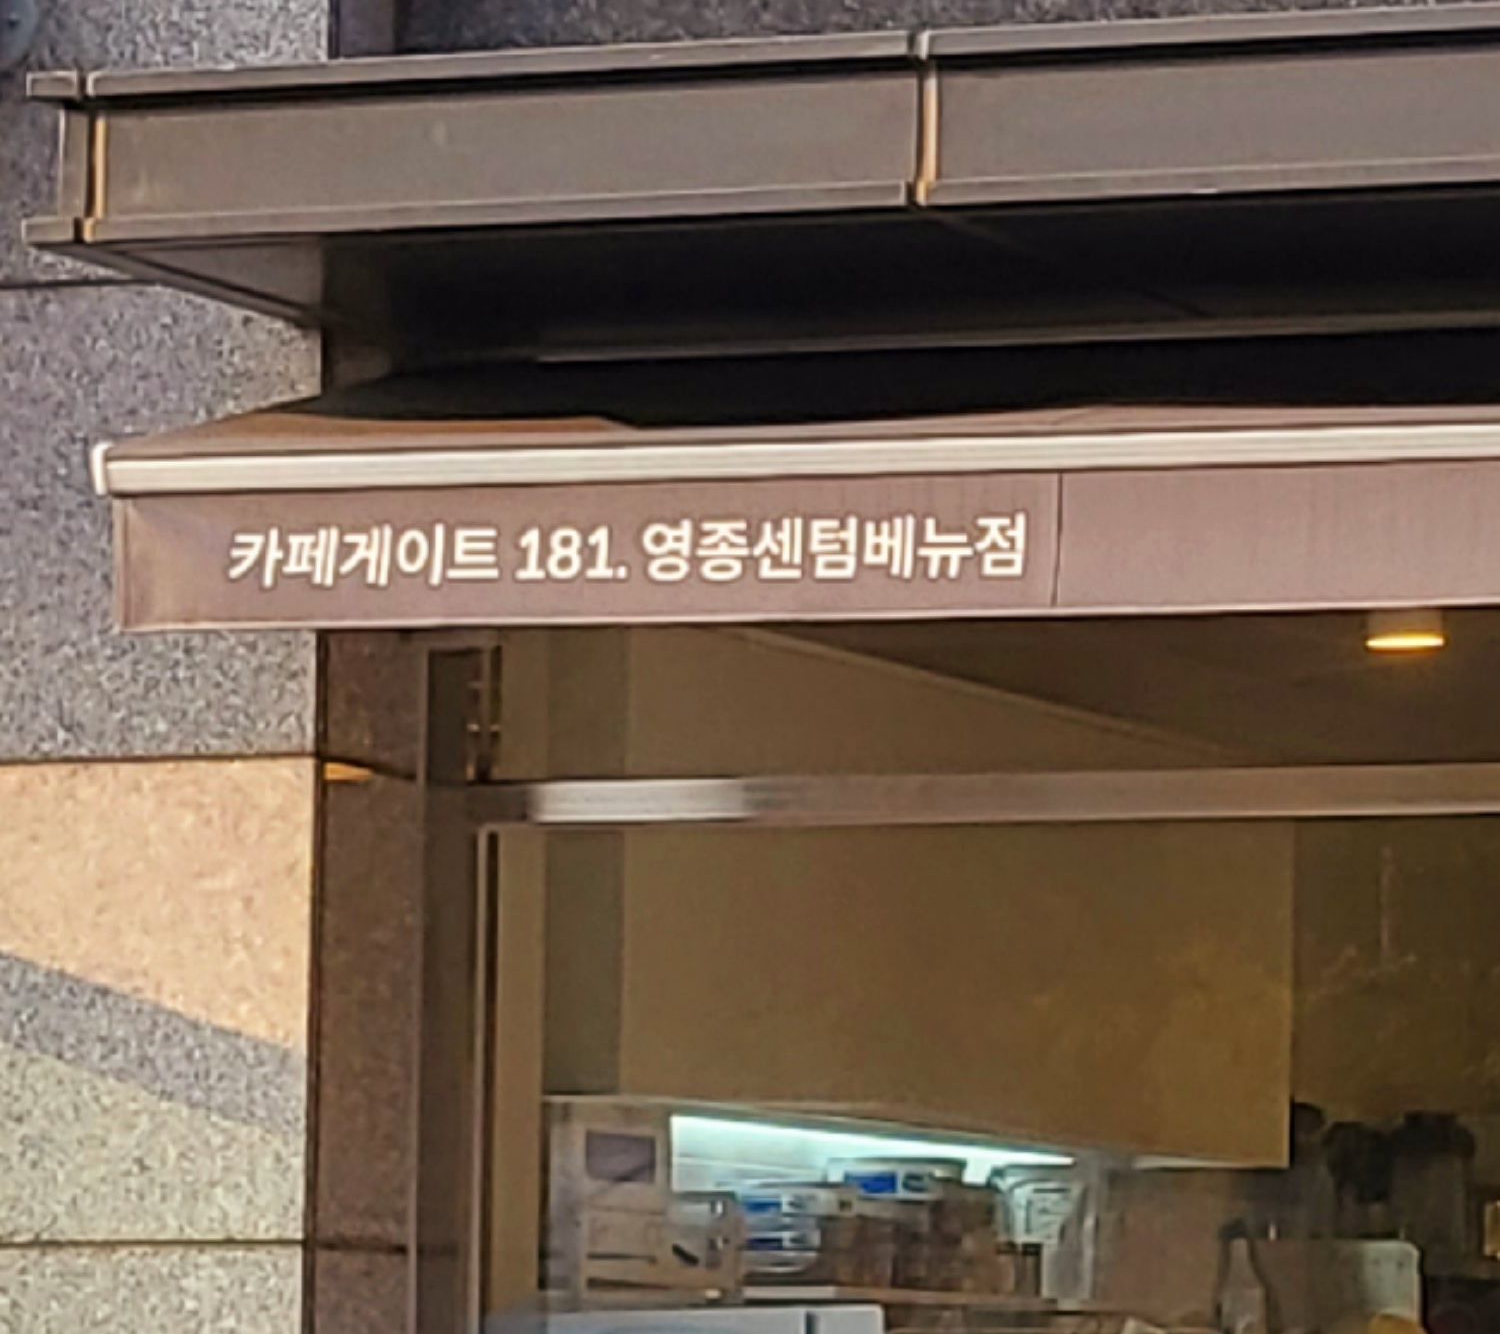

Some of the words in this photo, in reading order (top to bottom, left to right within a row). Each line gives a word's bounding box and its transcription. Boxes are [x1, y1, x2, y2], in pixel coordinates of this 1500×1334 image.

[228, 522, 500, 587] 카페게이트
[514, 527, 628, 581] 181.
[641, 512, 1029, 582] 영종센텀베뉴점
